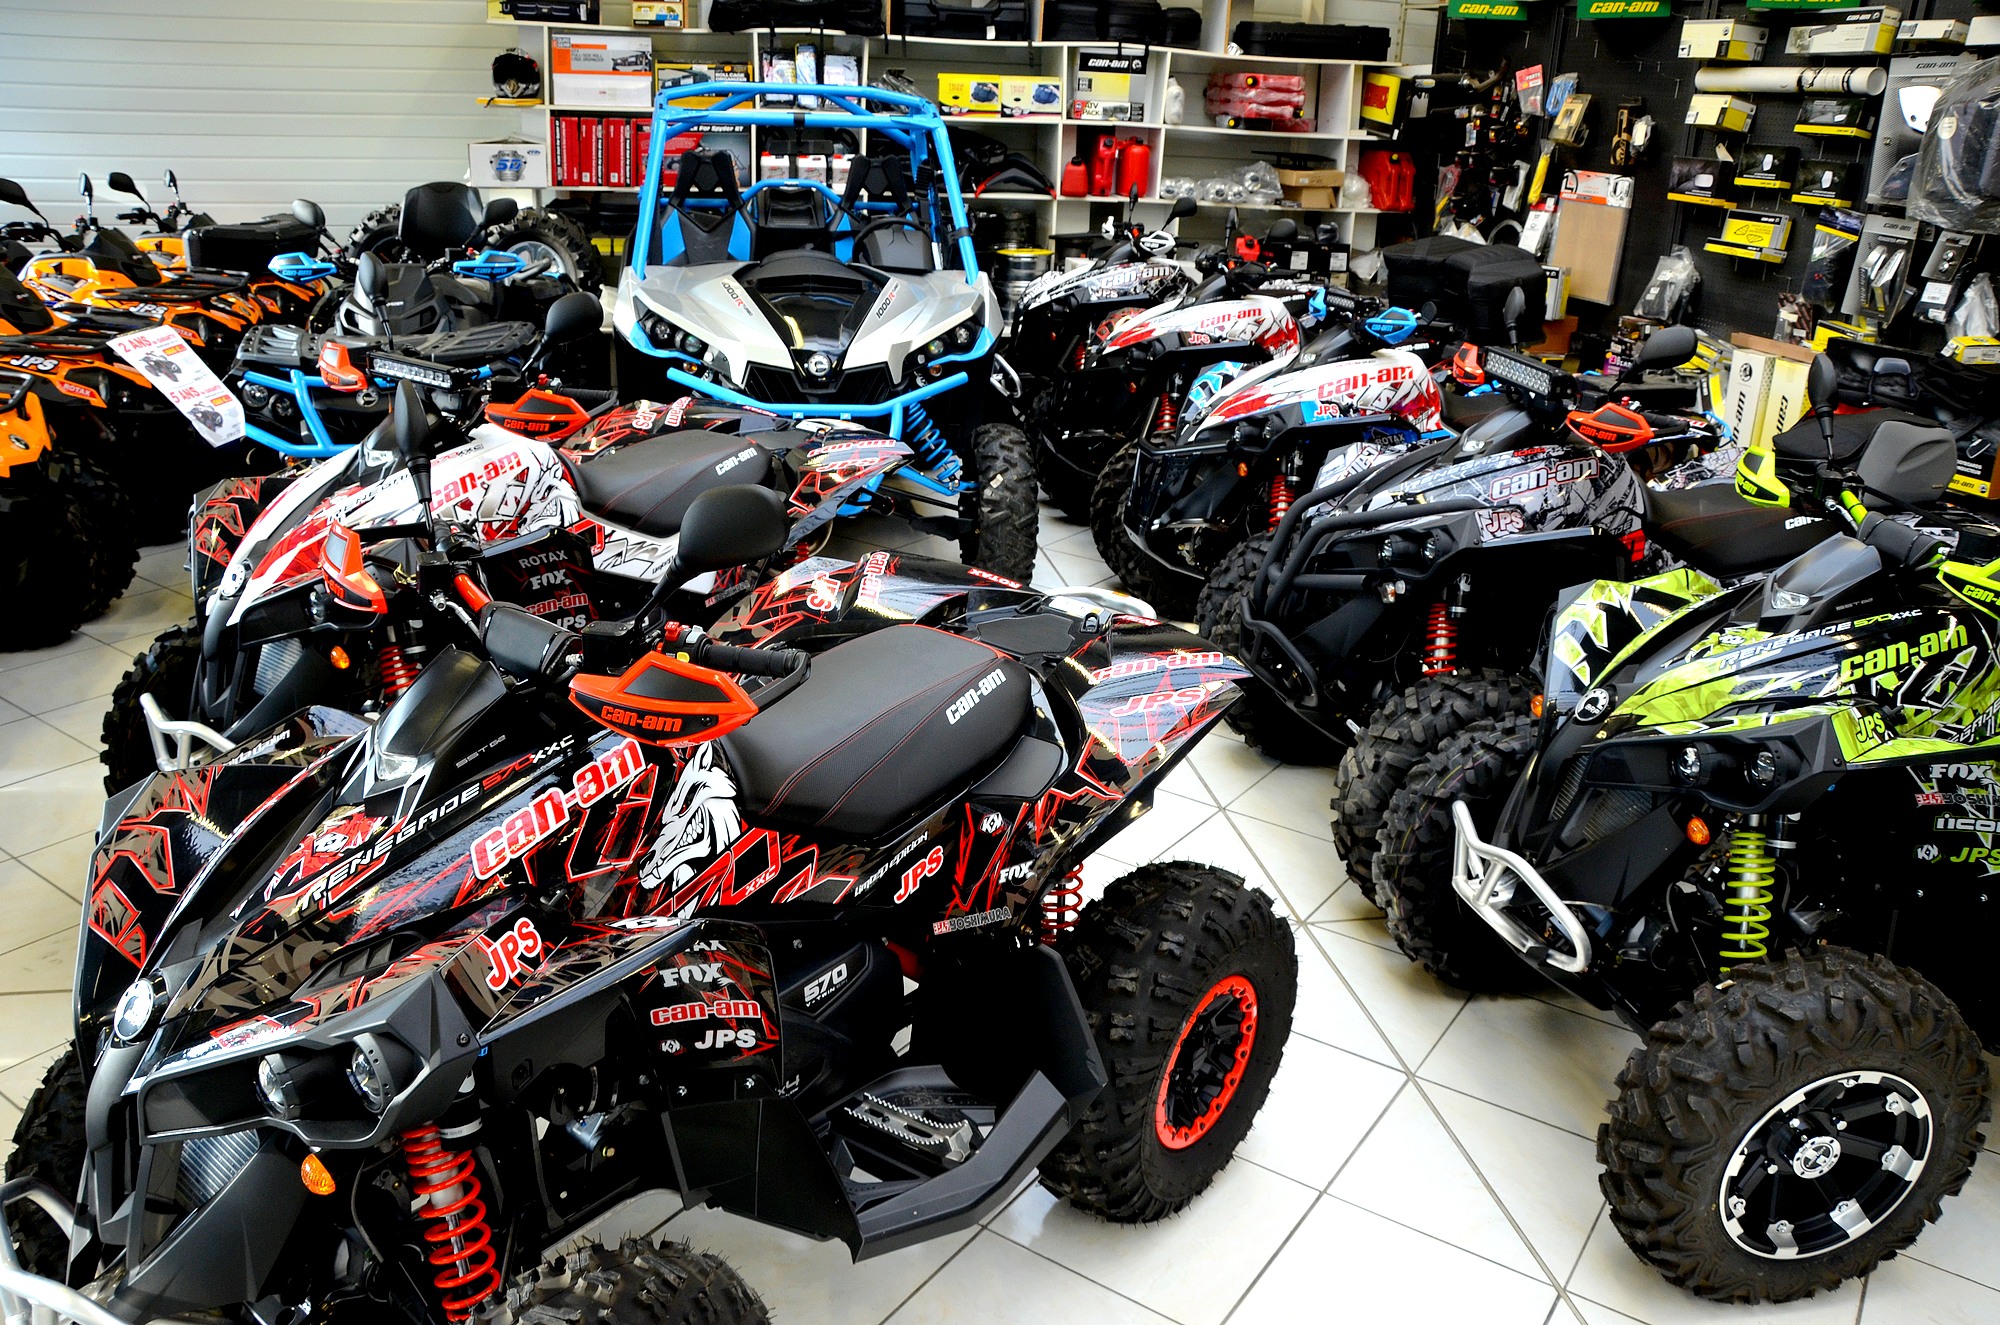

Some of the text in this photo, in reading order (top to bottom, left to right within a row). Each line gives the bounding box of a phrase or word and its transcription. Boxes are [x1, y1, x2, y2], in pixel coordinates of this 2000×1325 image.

[1458, 1, 1519, 16] can-am
[1590, 0, 1660, 14] can-am
[1088, 57, 1129, 68] can-am
[1916, 62, 1957, 70] can-am
[1102, 266, 1170, 288] can-am
[129, 302, 169, 319] JPS
[1200, 306, 1262, 329] can-am
[118, 342, 131, 354] 2
[132, 336, 153, 351] ANS
[1188, 333, 1211, 344] JPS
[10, 354, 59, 372] JPS
[63, 384, 92, 397] ROTAX
[1316, 364, 1414, 400] can-am
[170, 392, 180, 404] 5
[182, 386, 201, 401] ANS
[1316, 403, 1339, 417] JPS
[503, 418, 550, 432] can-am
[1580, 424, 1618, 442] can-am
[806, 439, 898, 458] can-am
[1374, 434, 1405, 447] ROTAX
[715, 446, 758, 476] can-am
[816, 456, 880, 472] JPS
[430, 451, 522, 513] can-am
[1489, 456, 1600, 502] can-am
[1485, 511, 1524, 534] JPS
[518, 550, 568, 569] ROTAX
[530, 568, 572, 590] FOX
[967, 567, 1022, 590] ROTAX
[806, 570, 841, 612] JPS
[524, 592, 589, 616] can-am
[1718, 621, 1852, 670] RENEGADE
[1854, 612, 1892, 628] 570
[1840, 624, 1968, 683] can-am
[1088, 652, 1224, 685] can-am
[945, 668, 1007, 726] can-am
[1110, 686, 1208, 718] JPS
[601, 706, 683, 733] can-am
[1856, 712, 1886, 743] JPS
[1929, 763, 1993, 782] FOX
[470, 738, 647, 881] can-am
[299, 734, 575, 912] RENEGADE 570 XXC
[1950, 846, 2000, 865] JPS
[744, 864, 776, 896] XXC
[894, 845, 944, 904] JPS
[998, 859, 1036, 884] FOX
[950, 906, 1012, 931] YOSHIMURA
[484, 918, 542, 992] JPS
[659, 962, 736, 988] FOX
[804, 962, 848, 1003] 570
[650, 1000, 762, 1026] can-am
[694, 1028, 756, 1050] JPS
